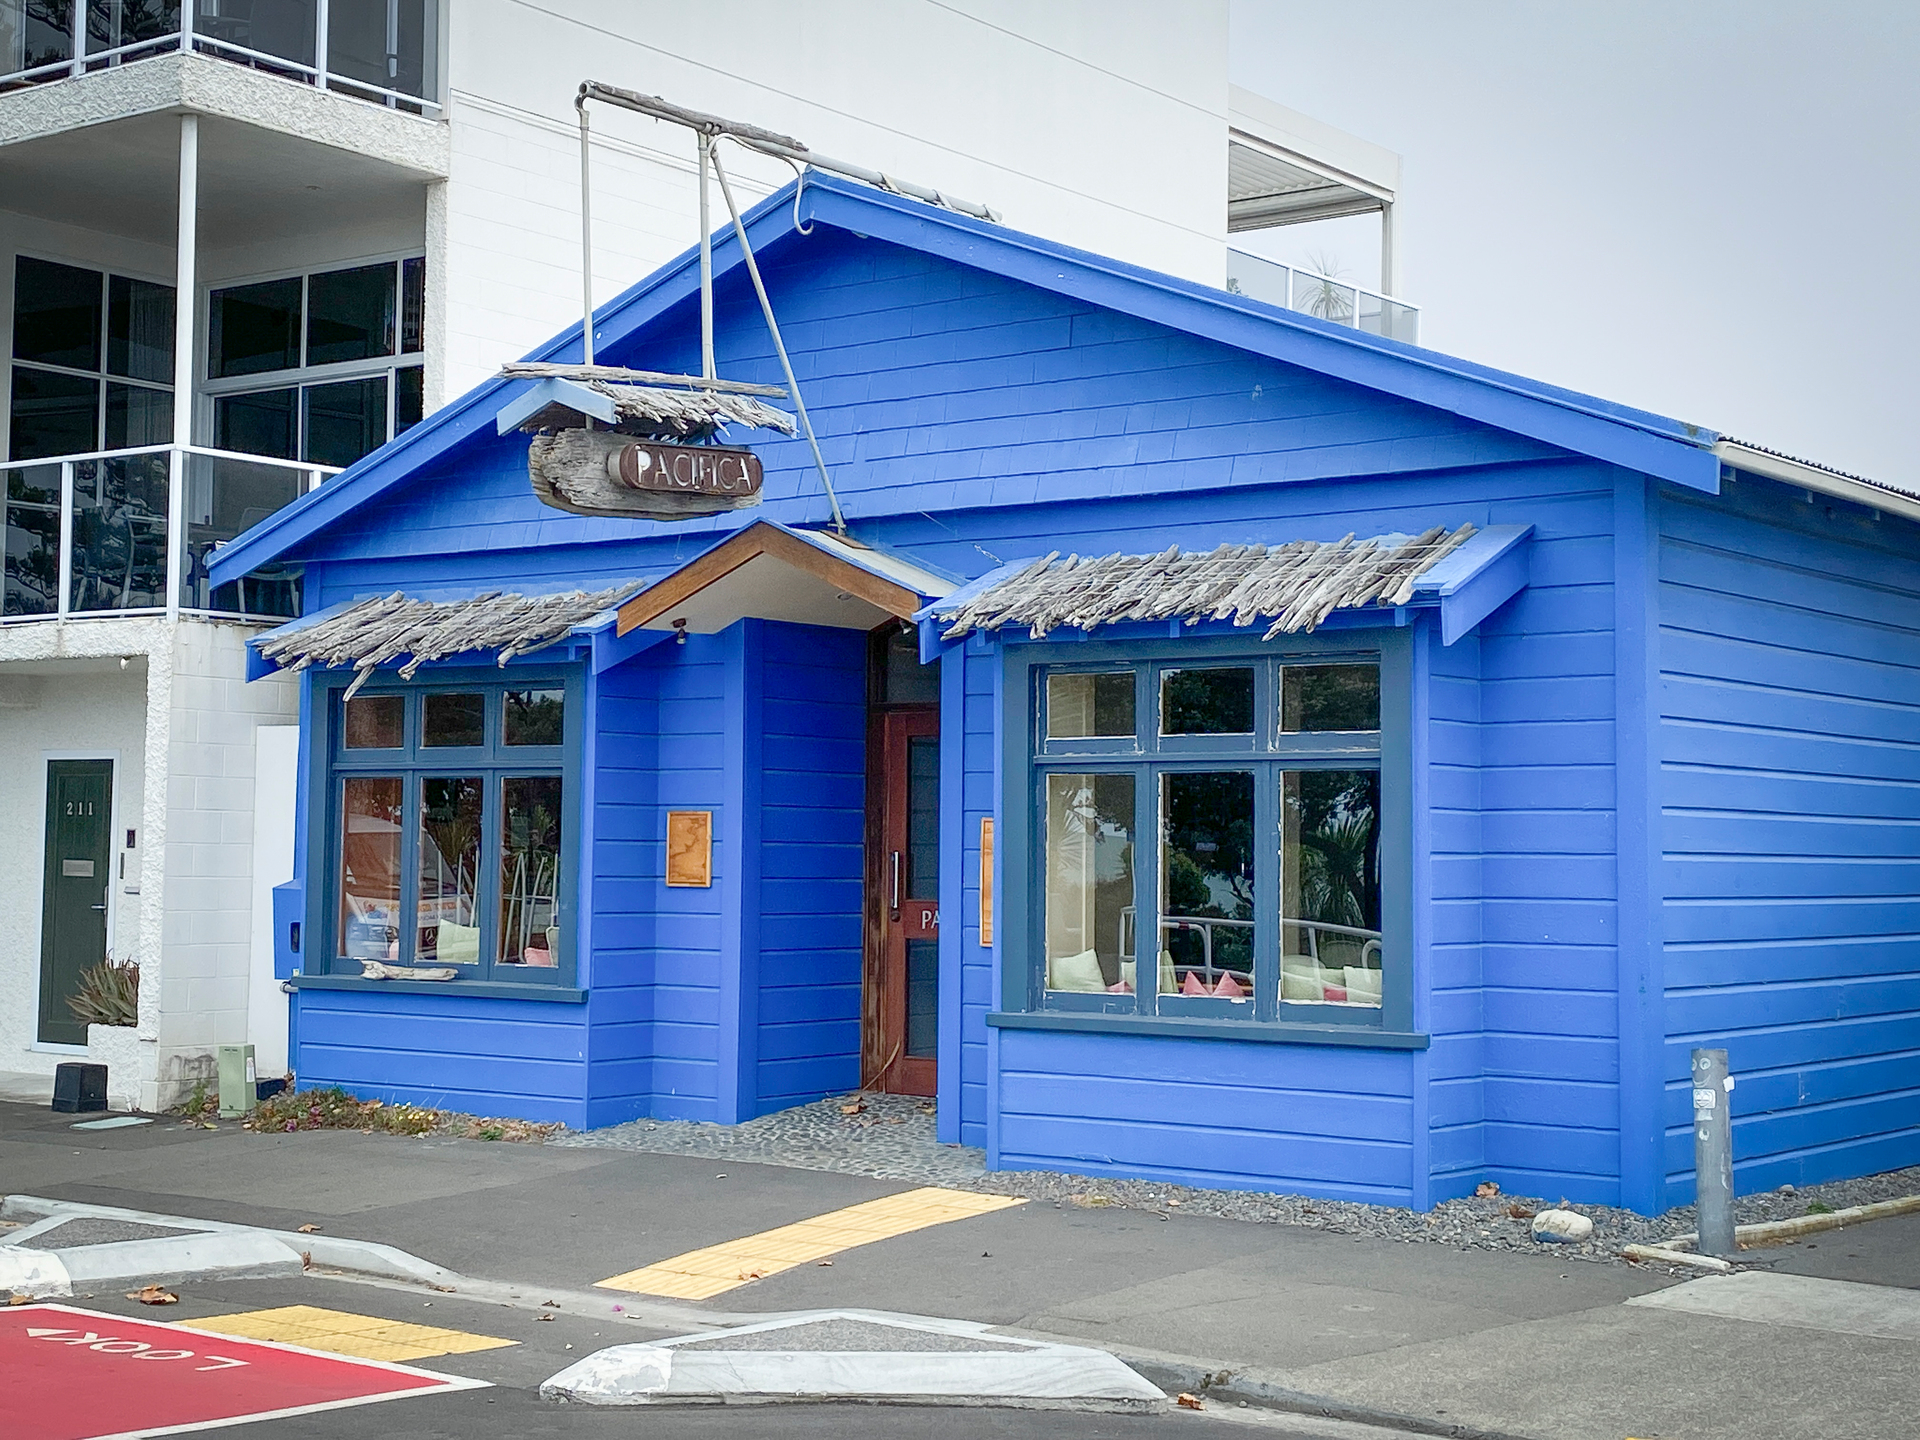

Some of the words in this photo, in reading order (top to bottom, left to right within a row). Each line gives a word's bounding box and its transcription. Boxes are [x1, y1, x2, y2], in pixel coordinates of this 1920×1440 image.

[636, 450, 752, 490] PACIFICA
[66, 801, 94, 816] 211
[37, 1331, 251, 1372] LOOK
